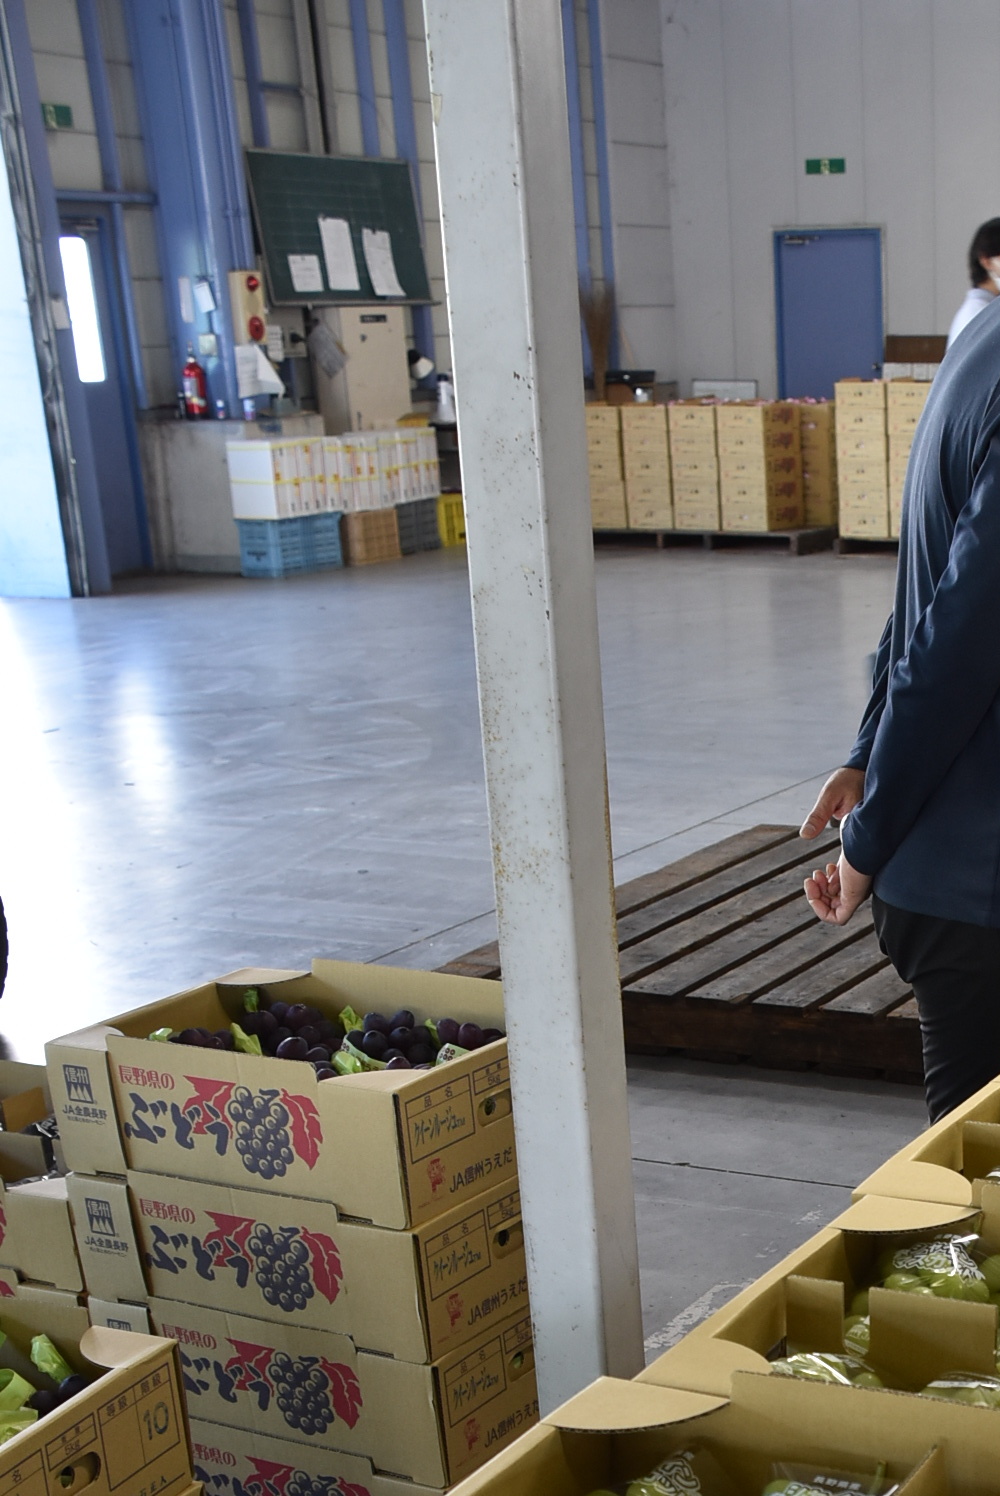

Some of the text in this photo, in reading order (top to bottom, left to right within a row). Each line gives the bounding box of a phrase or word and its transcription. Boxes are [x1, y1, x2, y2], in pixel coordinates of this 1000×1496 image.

[64, 1067, 89, 1085] 信州
[118, 1064, 175, 1091] 長野県の
[62, 1104, 107, 1120] JA全農長野
[123, 1092, 230, 1156] ぶどう
[449, 1146, 513, 1193] JA信州うえだ
[87, 1199, 111, 1218] 信州
[139, 1198, 196, 1225] 長野県の
[84, 1236, 129, 1252] JA全農長野
[145, 1225, 248, 1289] ぶどう
[467, 1275, 527, 1326] JA信州うえだ
[162, 1322, 217, 1350] 長野県の
[143, 1401, 169, 1440] 10
